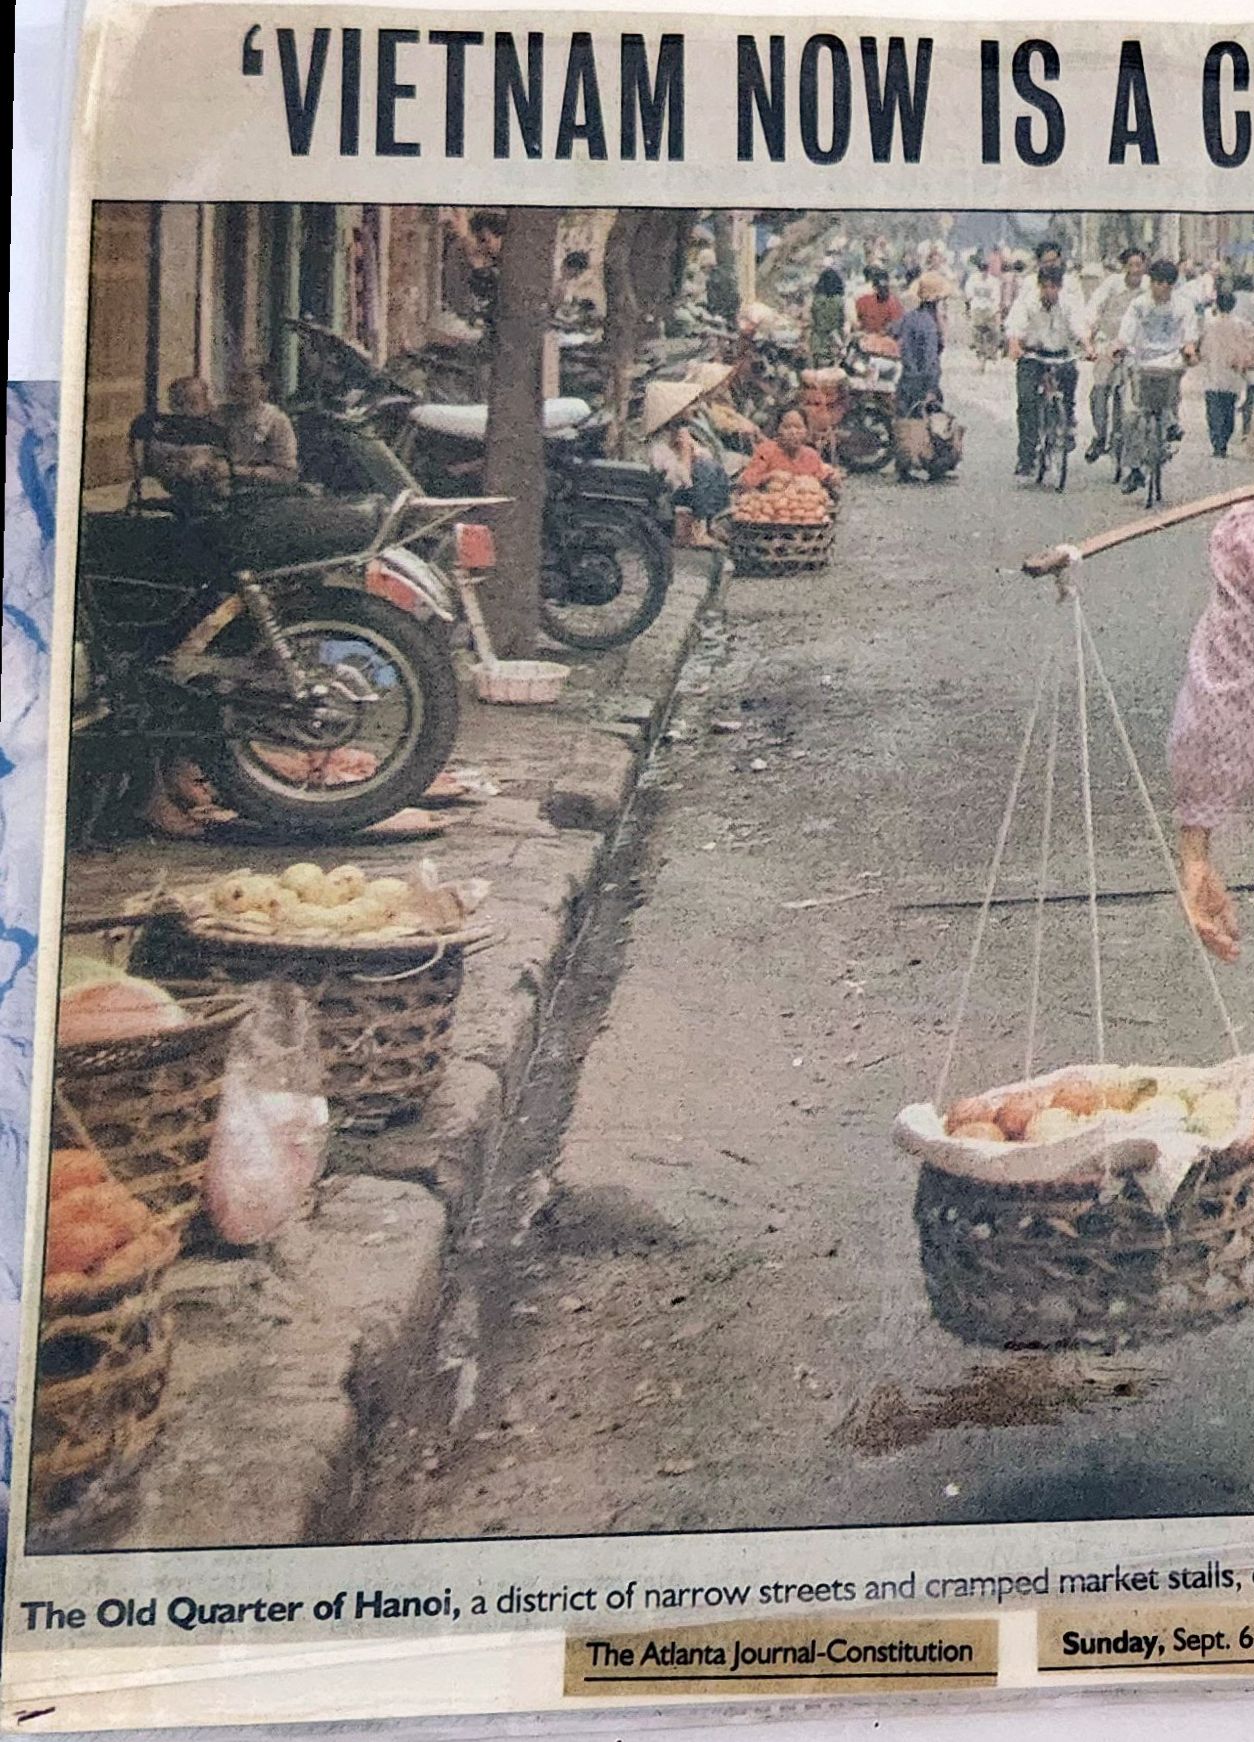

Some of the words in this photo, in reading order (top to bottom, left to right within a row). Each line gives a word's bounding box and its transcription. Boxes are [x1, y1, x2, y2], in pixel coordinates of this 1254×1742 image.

[736, 33, 934, 166] NOW
[980, 38, 1066, 167] IS
[1108, 40, 1160, 165] A
[19, 1600, 87, 1631] The
[96, 1597, 157, 1628] Old
[167, 1596, 304, 1631] Quarter
[313, 1591, 348, 1621] of
[354, 1587, 461, 1621] Hanoi,
[471, 1595, 488, 1615] a
[496, 1585, 598, 1614] district
[606, 1580, 636, 1610] of
[645, 1585, 751, 1608] narrow
[759, 1580, 856, 1604] streets
[864, 1570, 916, 1600] and
[925, 1566, 1049, 1605] cramped
[1059, 1564, 1160, 1594] market
[1168, 1560, 1242, 1592] stalls,
[585, 1641, 635, 1667] The
[639, 1640, 727, 1667] Atlanta
[731, 1638, 973, 1671] Journal-Constitution
[1062, 1629, 1165, 1659] Sunday,
[1173, 1627, 1231, 1658] Sept.
